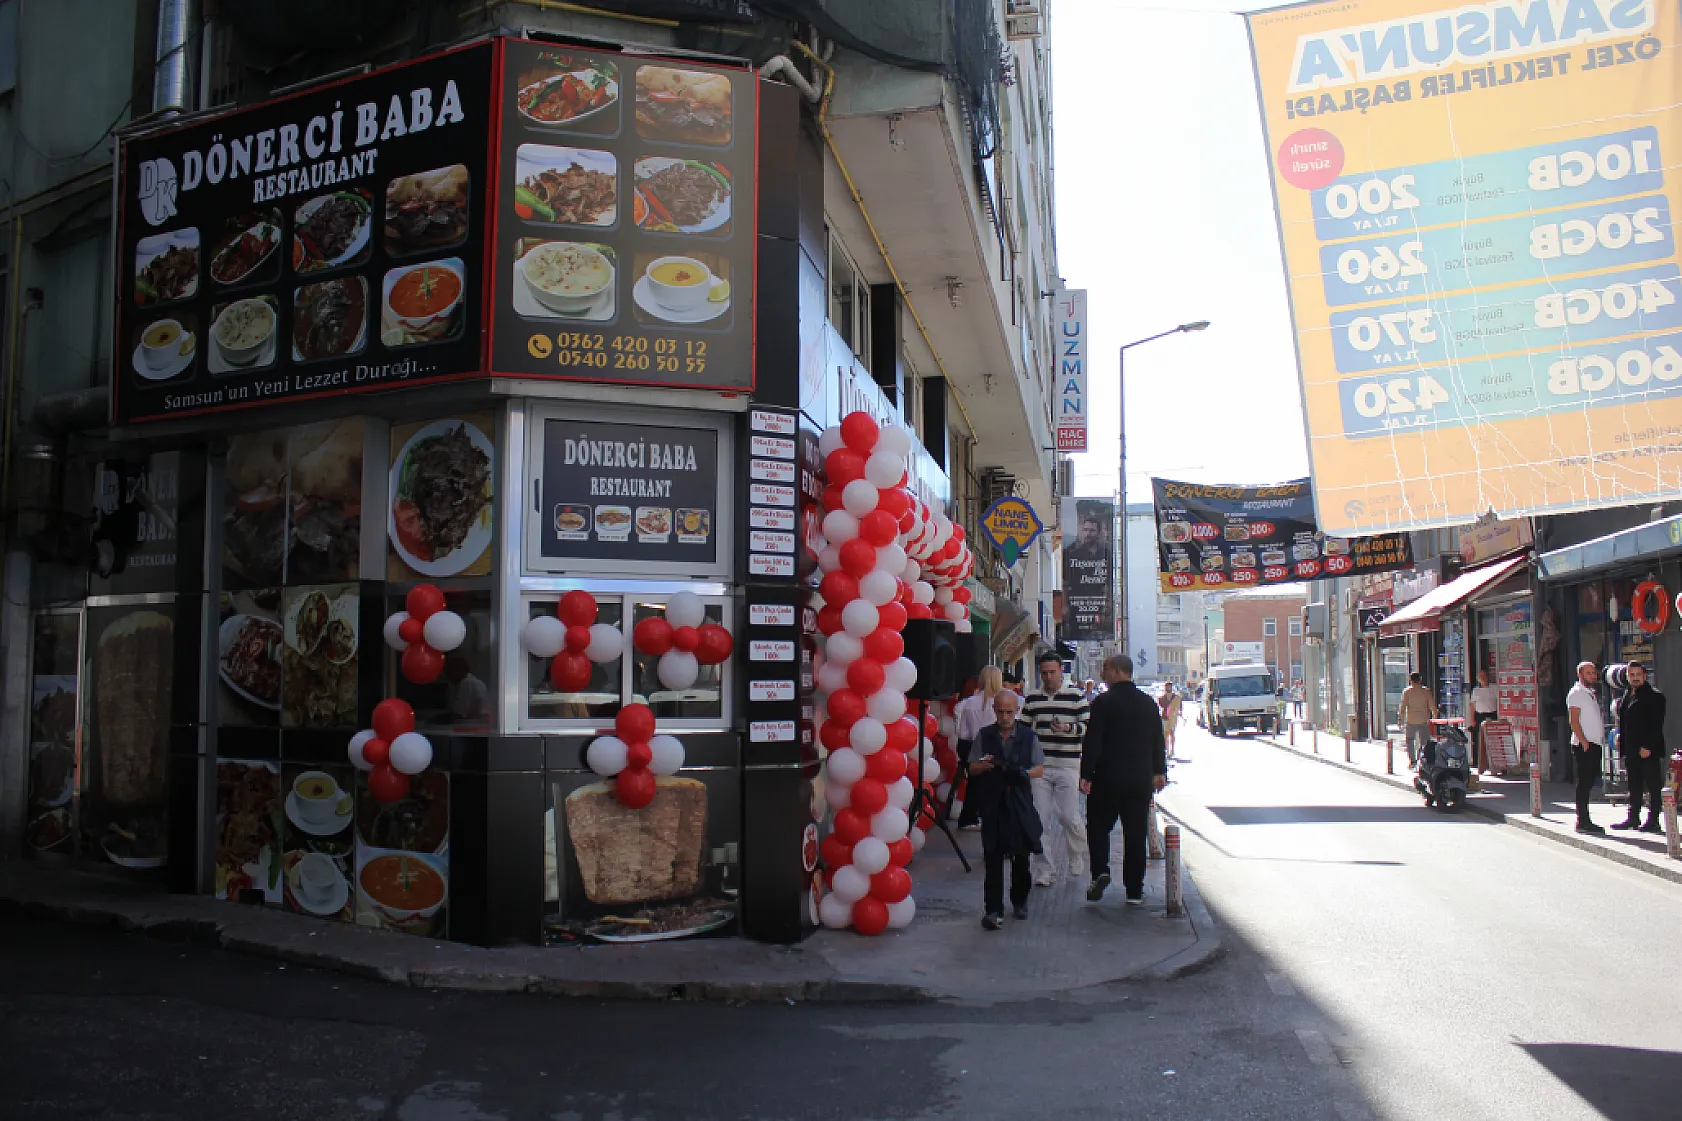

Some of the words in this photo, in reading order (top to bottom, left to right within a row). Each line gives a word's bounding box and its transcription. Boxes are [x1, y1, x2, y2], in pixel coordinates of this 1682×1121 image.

[182, 100, 344, 193] DÖNERCİ
[354, 79, 465, 147] BABA
[252, 149, 379, 203] RESTAURANT
[557, 331, 606, 353] 0362
[611, 334, 648, 353] 420
[653, 337, 678, 355] 03
[685, 339, 707, 358] 12
[557, 350, 608, 369] 0540
[614, 352, 650, 371] 260
[655, 354, 680, 372] 50
[685, 357, 707, 374] 55
[1062, 321, 1082, 415] UZMAN
[164, 384, 248, 410] Samsun'un
[254, 376, 289, 398] Yeni
[295, 368, 349, 390] Lezzet
[1060, 429, 1085, 439] HAC
[563, 433, 645, 469] DÖNERCİ
[649, 443, 698, 472] BABA
[589, 476, 673, 498] RESTAURANT
[995, 507, 1028, 520] NANE
